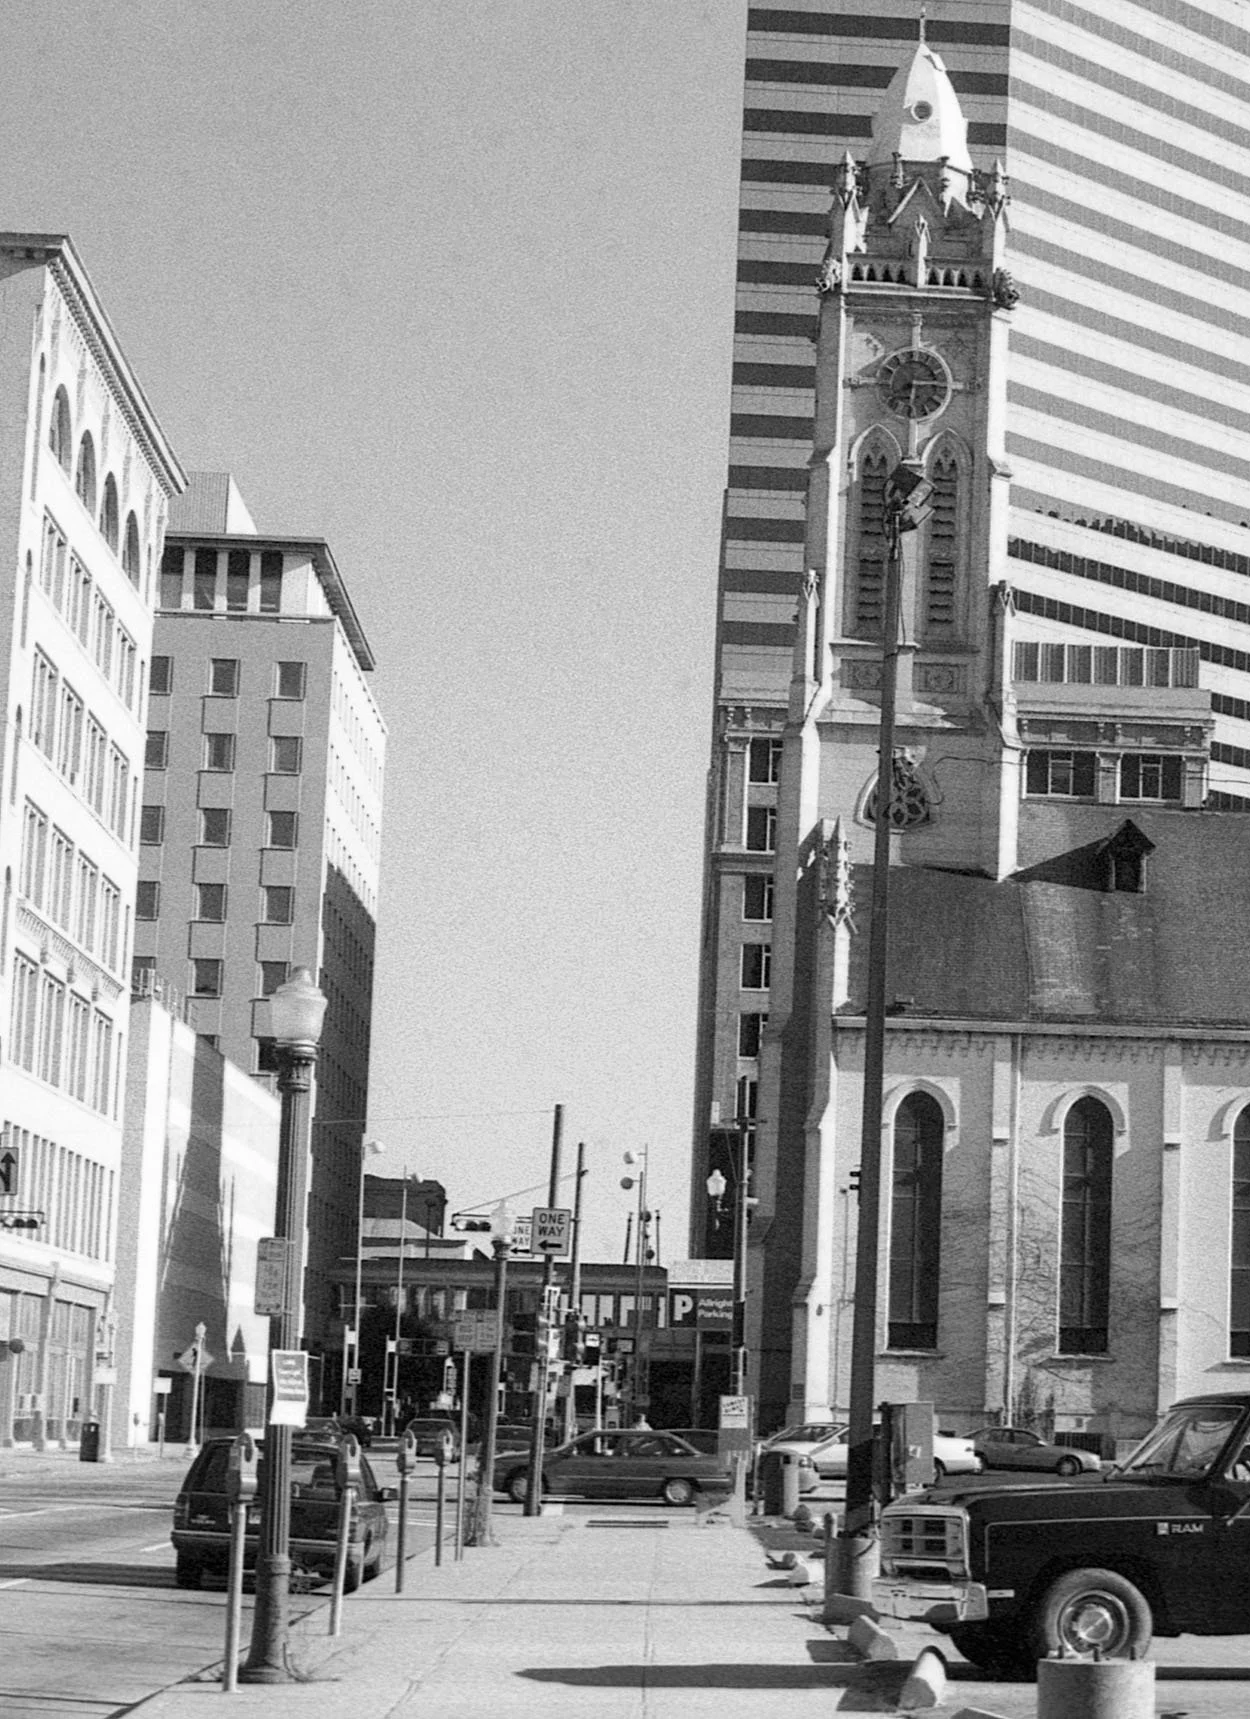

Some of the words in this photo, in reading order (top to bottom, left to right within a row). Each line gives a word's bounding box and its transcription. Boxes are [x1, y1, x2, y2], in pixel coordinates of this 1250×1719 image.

[539, 1213, 565, 1224] ONE
[538, 1225, 565, 1237] WAY
[674, 1294, 693, 1321] P
[698, 1309, 733, 1320] Parking
[1171, 1523, 1204, 1533] RAM
